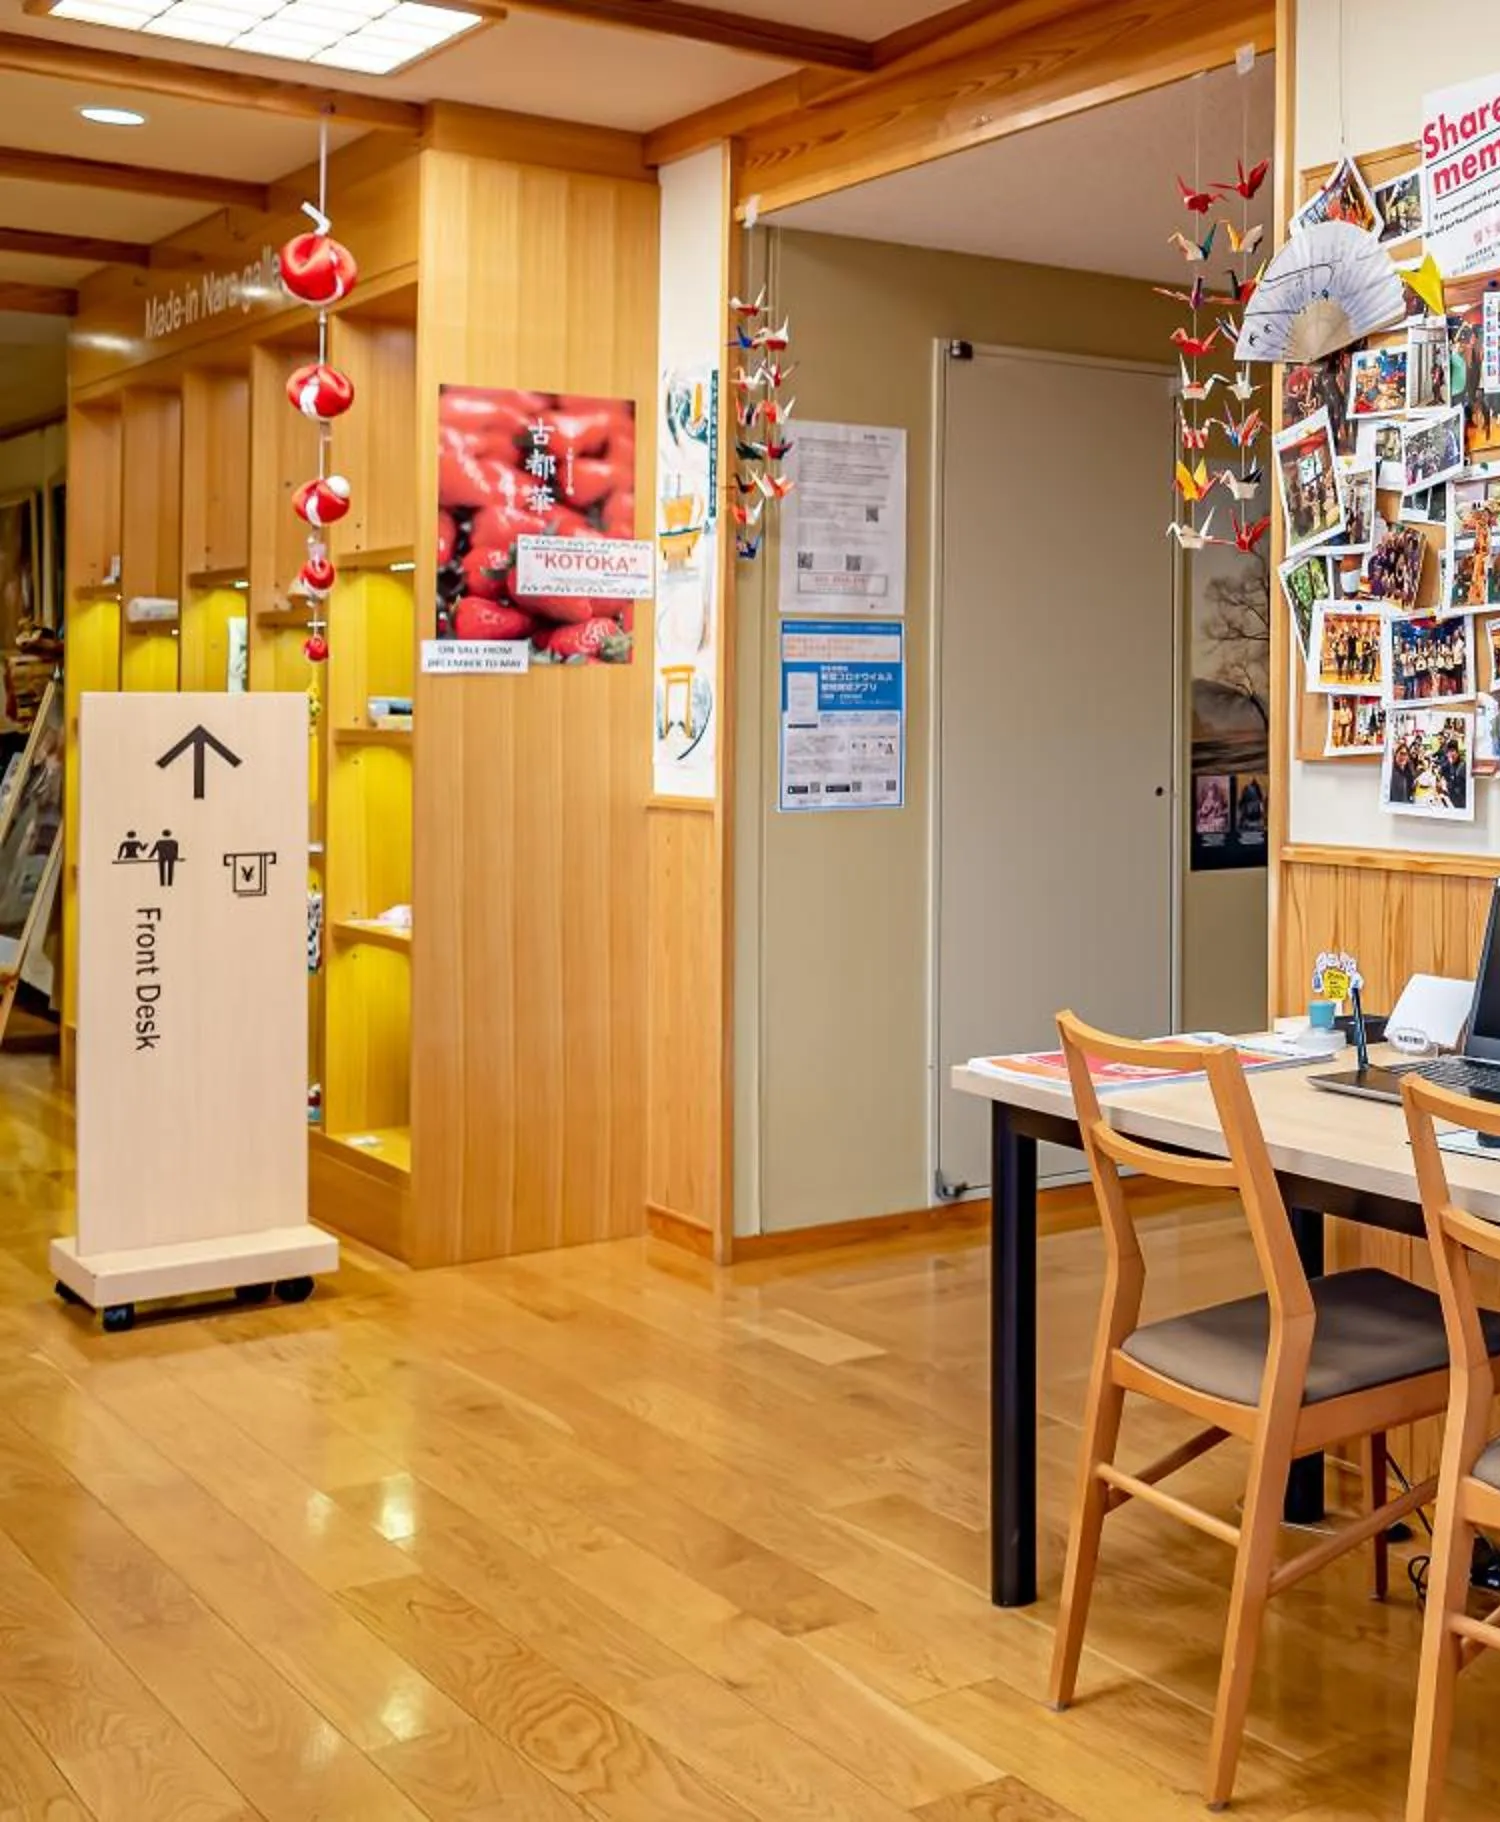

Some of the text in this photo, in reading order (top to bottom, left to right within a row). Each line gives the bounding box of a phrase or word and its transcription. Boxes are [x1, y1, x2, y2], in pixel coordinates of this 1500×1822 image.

[145, 282, 199, 338] Made-in
[135, 907, 161, 1052] Front Desk
